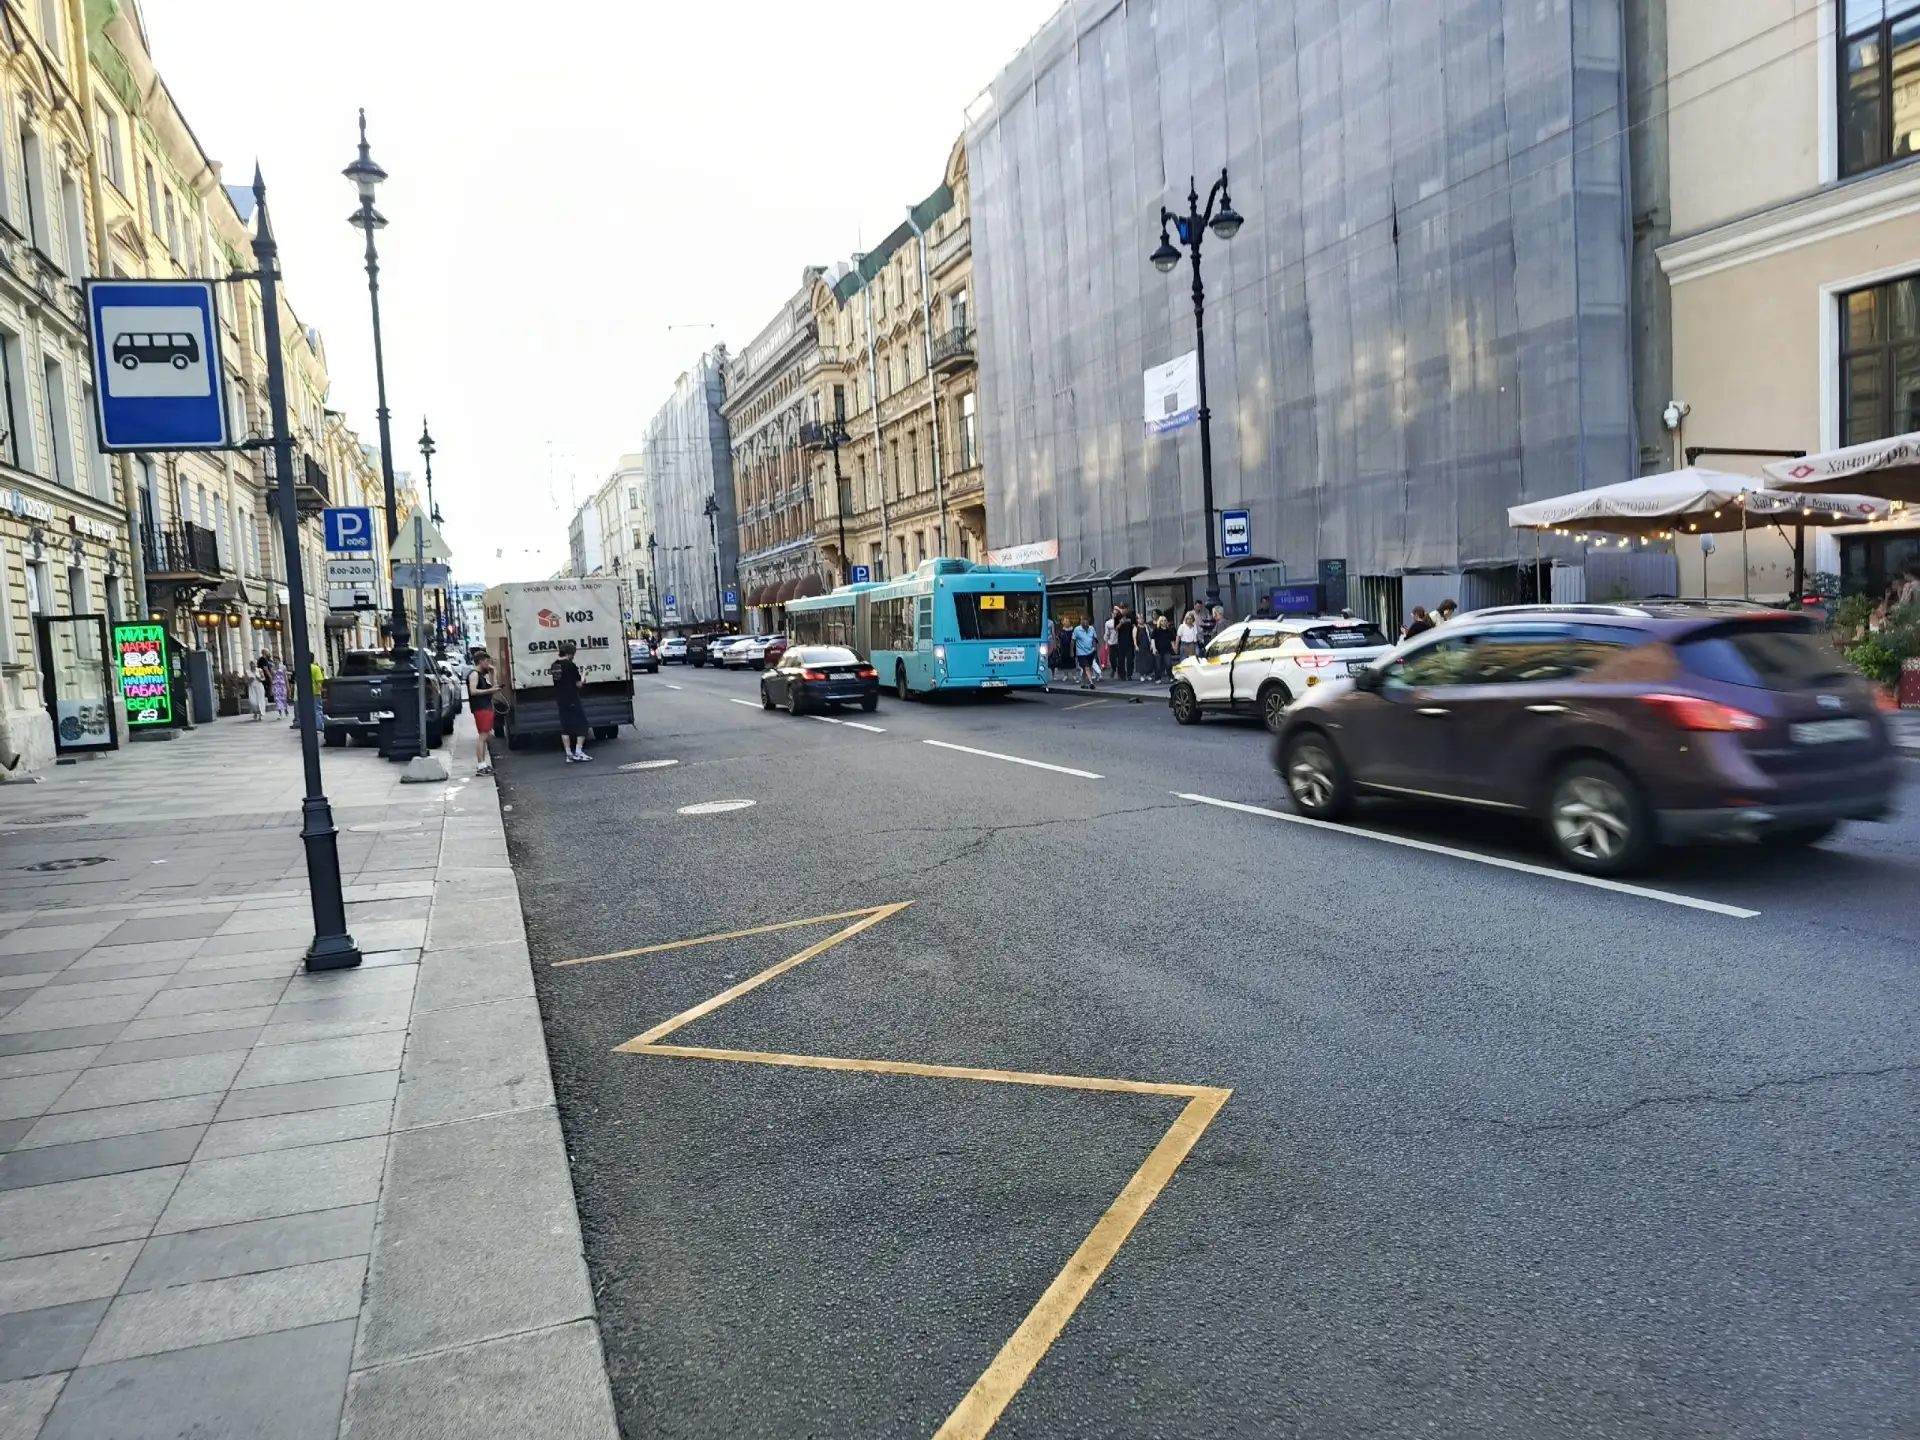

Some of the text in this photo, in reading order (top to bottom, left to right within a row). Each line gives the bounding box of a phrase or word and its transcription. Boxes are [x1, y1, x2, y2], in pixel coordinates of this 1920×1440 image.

[336, 513, 363, 547] P
[330, 566, 371, 575] 8.00-20.00
[856, 567, 867, 582] P
[989, 597, 995, 607] 2
[565, 610, 594, 623] КФЗ
[120, 628, 161, 642] МИНИ
[120, 641, 160, 652] МАРКЕТ
[124, 650, 160, 667] 24
[125, 684, 166, 697] ТАБАК
